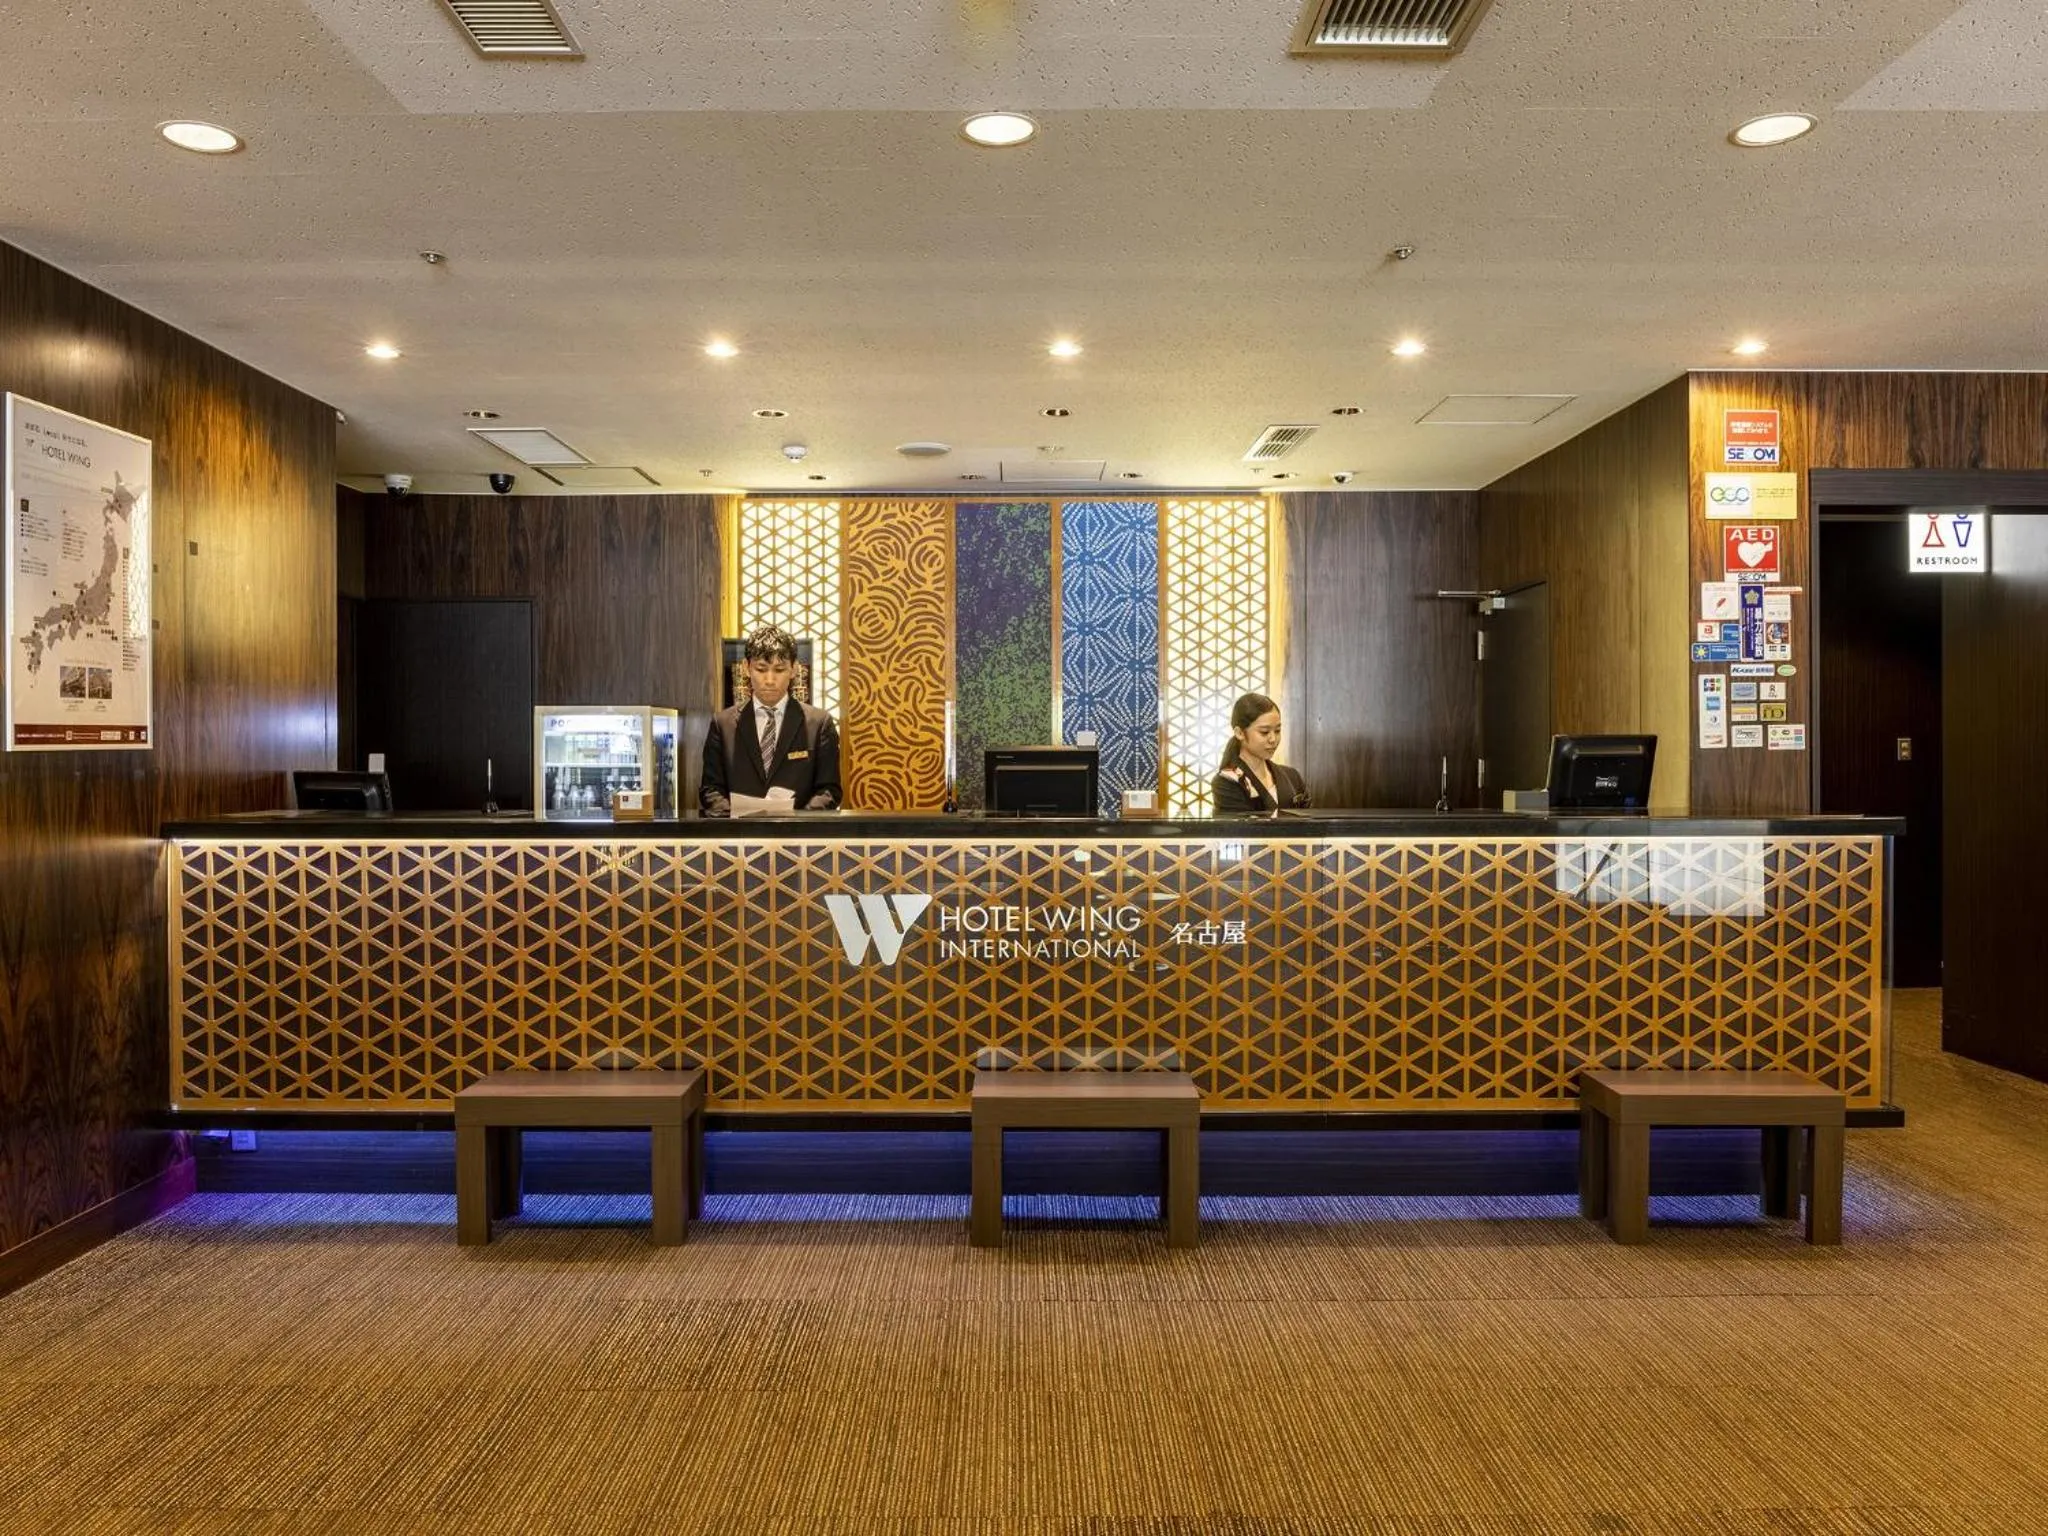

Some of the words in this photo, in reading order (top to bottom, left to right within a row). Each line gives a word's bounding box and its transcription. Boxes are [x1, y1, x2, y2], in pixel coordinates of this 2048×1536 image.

[41, 444, 66, 461] HOTEL
[66, 451, 91, 469] WING
[1729, 528, 1775, 541] AED
[1916, 556, 1978, 565] RESTROOM
[940, 905, 1035, 933] HOTEL
[1042, 905, 1141, 933] WING
[1169, 920, 1248, 946] 名古屋
[940, 938, 1141, 959] INTERNATIONAL
